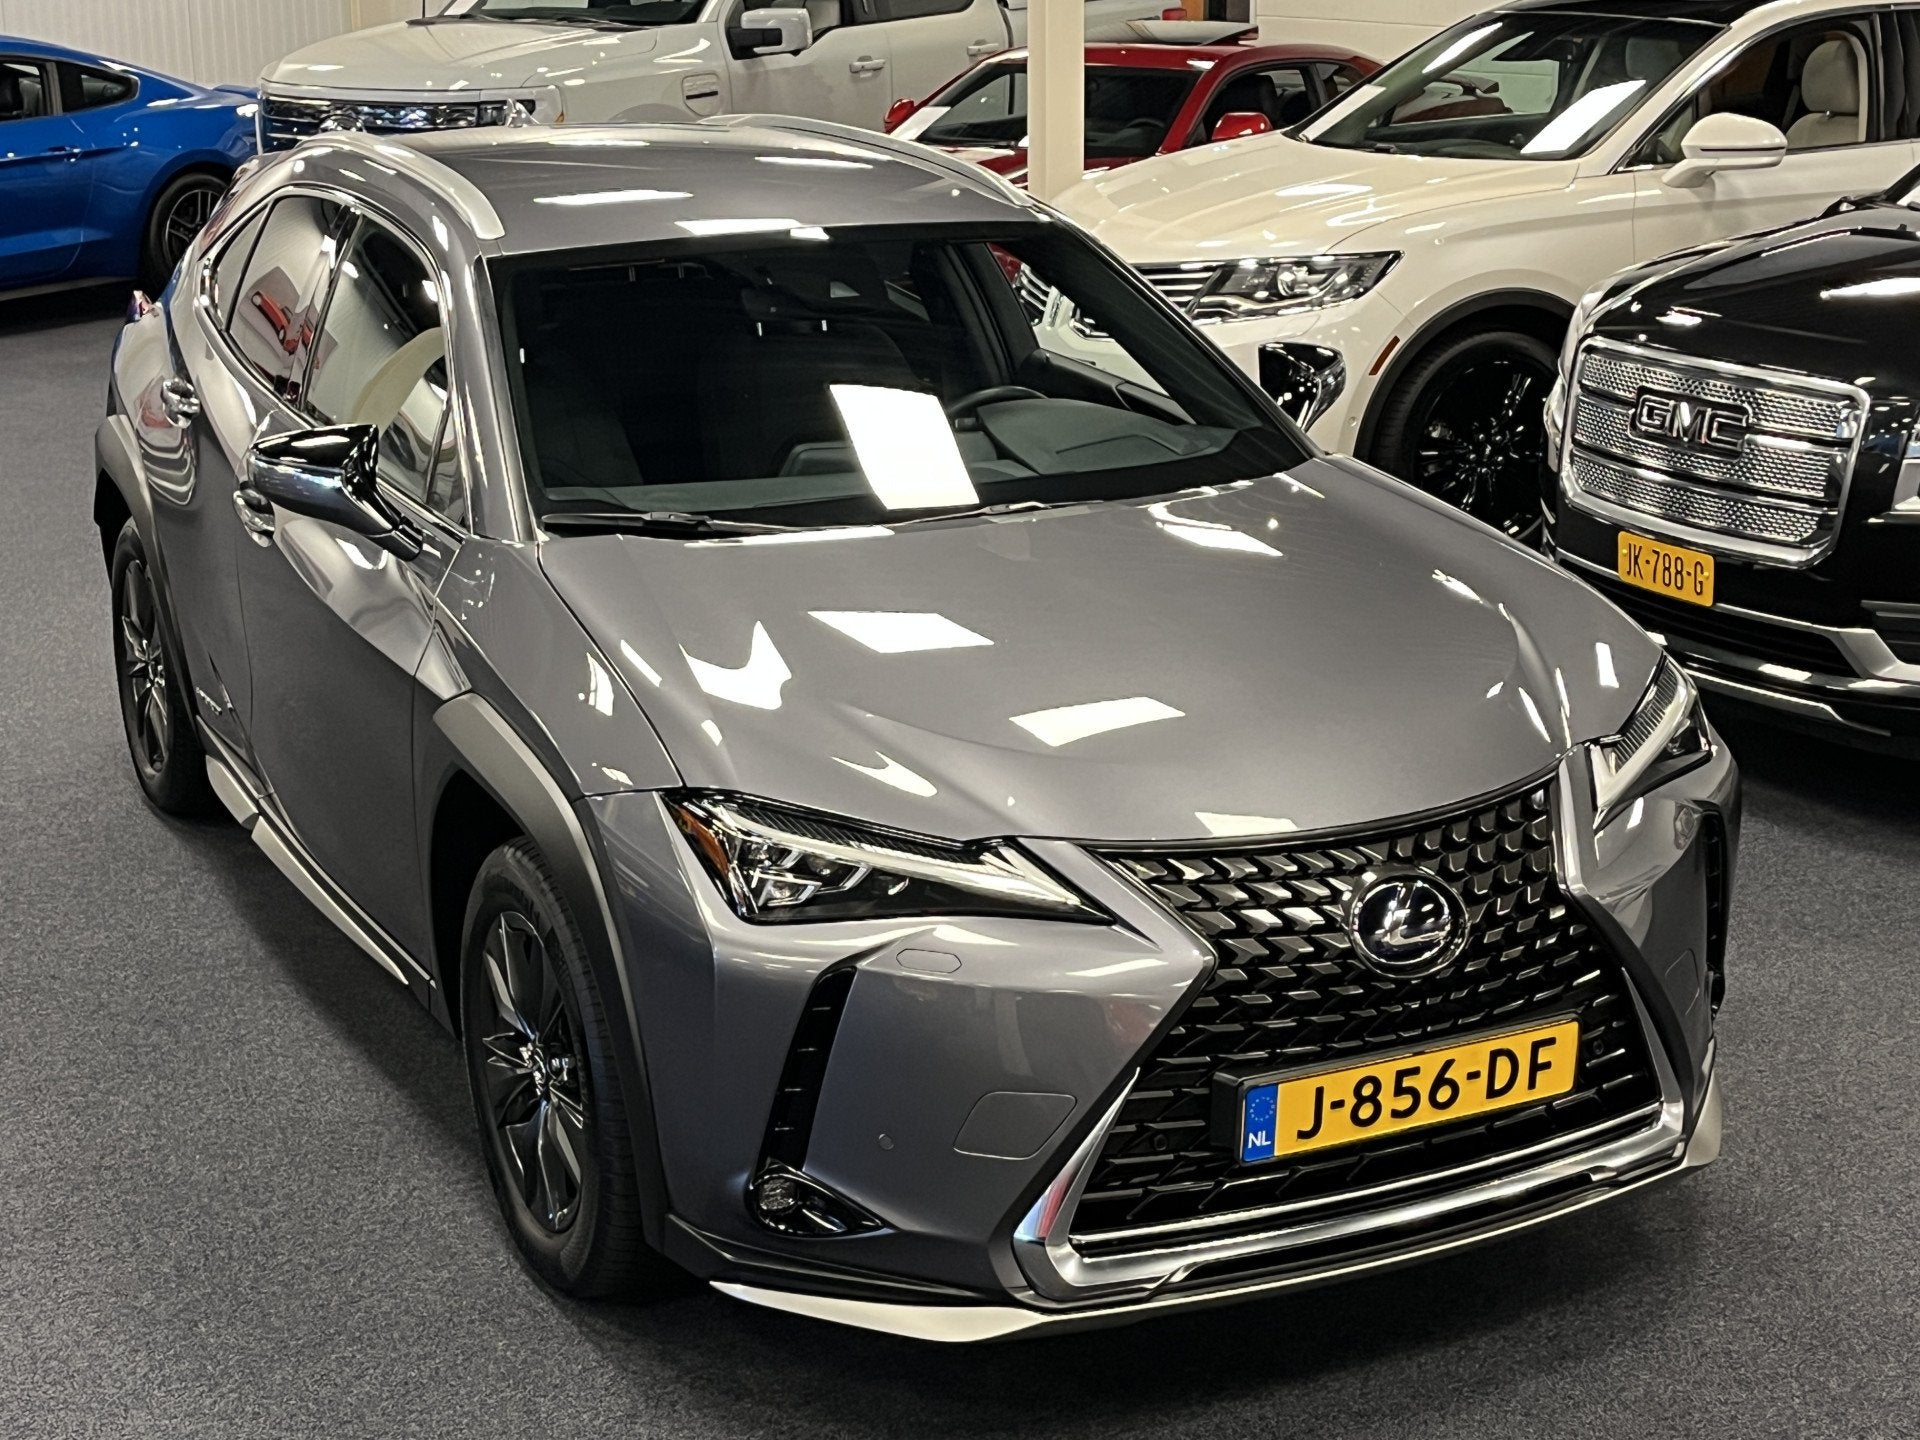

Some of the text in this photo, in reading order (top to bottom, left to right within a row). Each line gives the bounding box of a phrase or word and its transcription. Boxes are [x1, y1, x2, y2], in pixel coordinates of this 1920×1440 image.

[1636, 394, 1748, 451] GMC
[1626, 542, 1704, 596] JK-788-G
[1295, 1036, 1557, 1141] J-856-DF
[1247, 1130, 1272, 1149] NL
